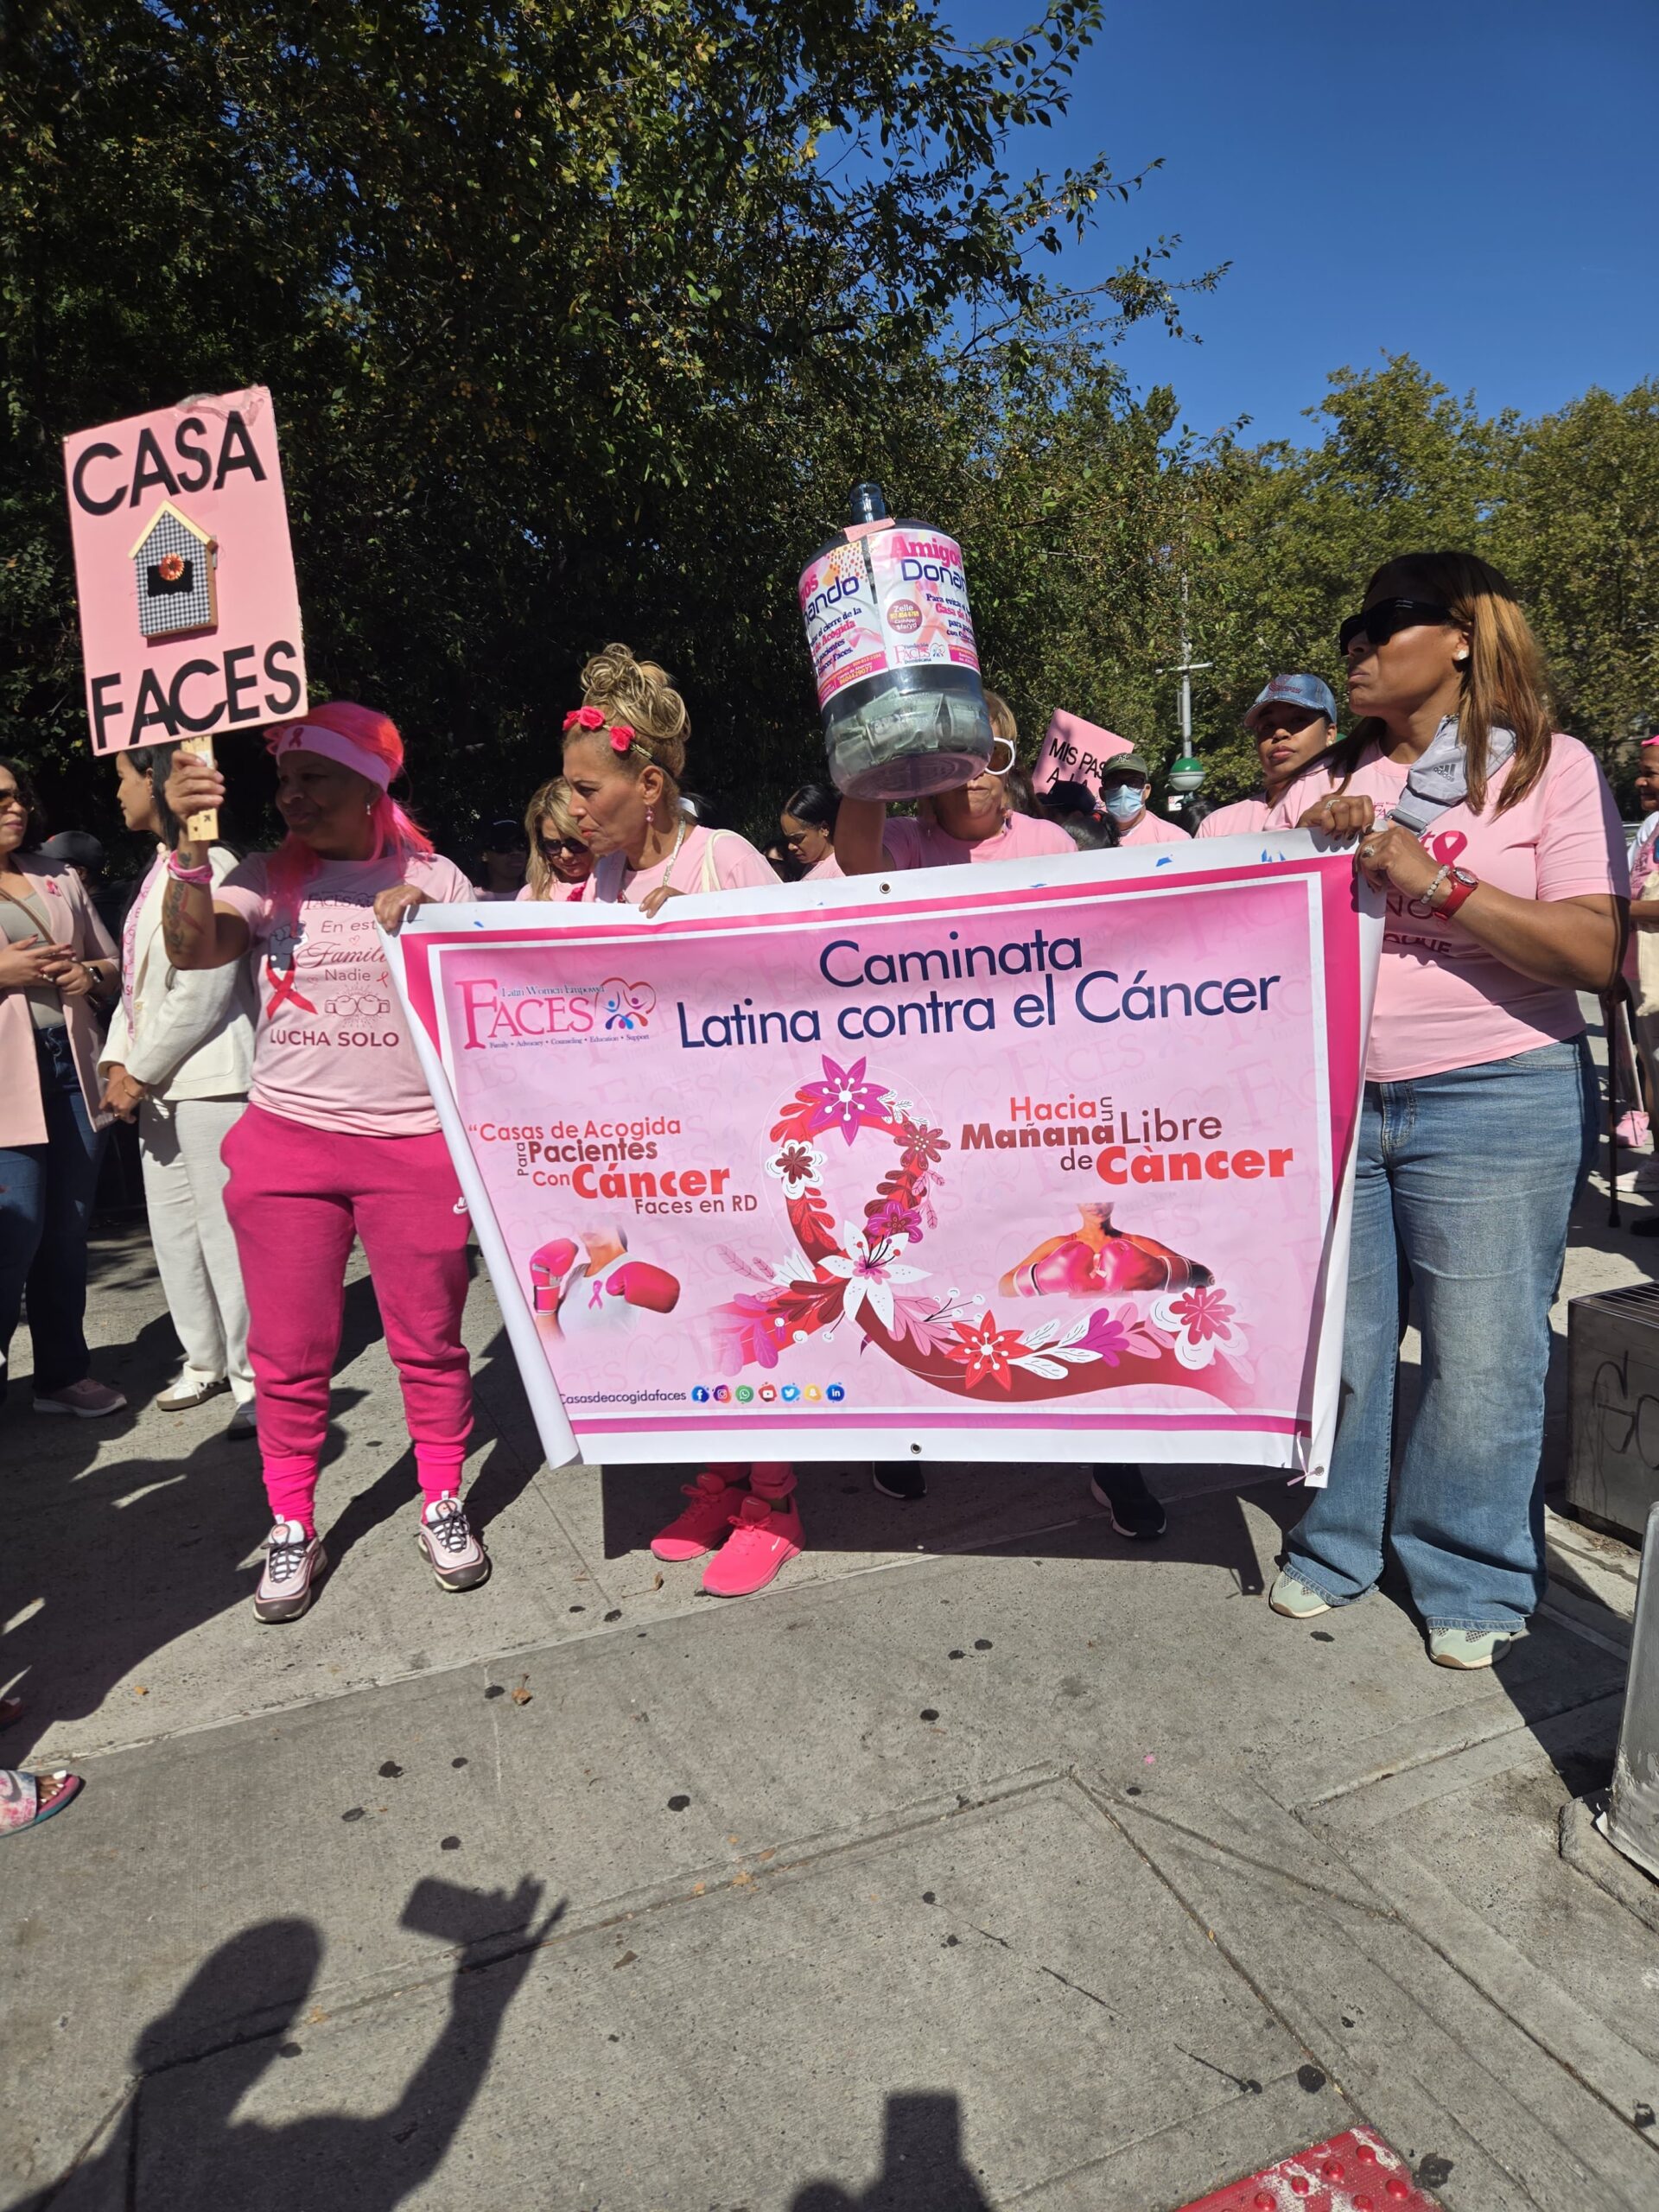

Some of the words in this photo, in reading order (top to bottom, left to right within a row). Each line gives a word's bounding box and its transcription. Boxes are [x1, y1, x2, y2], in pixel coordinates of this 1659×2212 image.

[73, 410, 267, 516] CASA
[842, 611, 853, 620] de
[853, 607, 862, 615] la
[893, 604, 914, 613] Zelle
[822, 620, 856, 644] Acogida
[91, 640, 301, 749] FACES
[1049, 738, 1077, 766] MIS
[1079, 752, 1107, 779] PAS
[1046, 767, 1060, 784] A
[1433, 766, 1455, 782] adidas
[304, 892, 353, 911] FACES
[321, 920, 343, 932] En
[351, 920, 377, 931] est
[296, 942, 386, 969] Famili
[819, 929, 1083, 988] Caminata
[325, 969, 371, 982] Nadie
[501, 987, 524, 998] Latin
[526, 985, 563, 996] Women
[454, 978, 594, 1051] FACES
[677, 998, 821, 1048] Latina
[836, 989, 995, 1039] contra
[1014, 975, 1056, 1027] el
[1075, 969, 1281, 1025] Cáncer
[270, 1028, 330, 1046] LUCHA
[338, 1031, 399, 1047] SOLO
[489, 1040, 509, 1050] Family
[589, 1035, 620, 1044] Education
[626, 1033, 650, 1042] Support
[1009, 1092, 1096, 1122] Hacia
[1100, 1096, 1114, 1122] un
[550, 1121, 579, 1139] de
[584, 1116, 682, 1141] Acogida
[960, 1122, 1115, 1151] Mañana
[1121, 1108, 1223, 1145] Libre
[517, 1142, 530, 1177] Para
[529, 1137, 658, 1164] Pacientes
[1060, 1147, 1093, 1172] de
[532, 1171, 570, 1187] Con
[571, 1162, 730, 1199] Cáncer
[635, 1197, 693, 1215] Faces
[700, 1198, 725, 1212] en
[732, 1194, 758, 1212] RD
